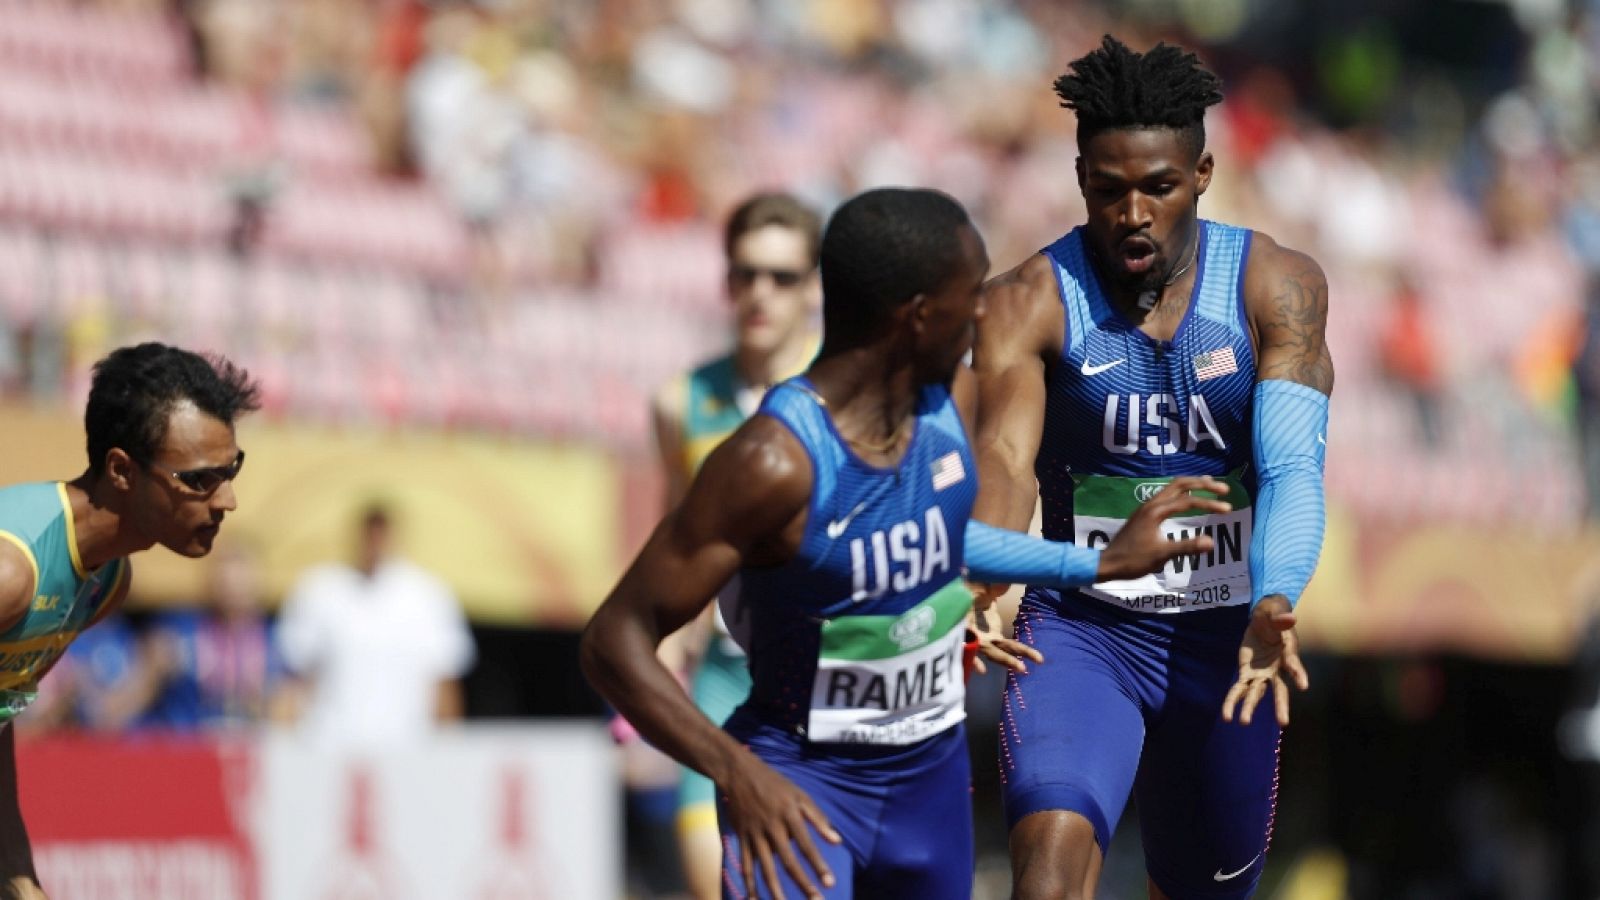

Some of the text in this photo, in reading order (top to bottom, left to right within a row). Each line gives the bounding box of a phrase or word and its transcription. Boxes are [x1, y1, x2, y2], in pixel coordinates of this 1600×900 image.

[1102, 393, 1226, 456] USA
[850, 505, 950, 601] USA
[1087, 521, 1243, 575] WIN
[1191, 583, 1231, 606] 2018
